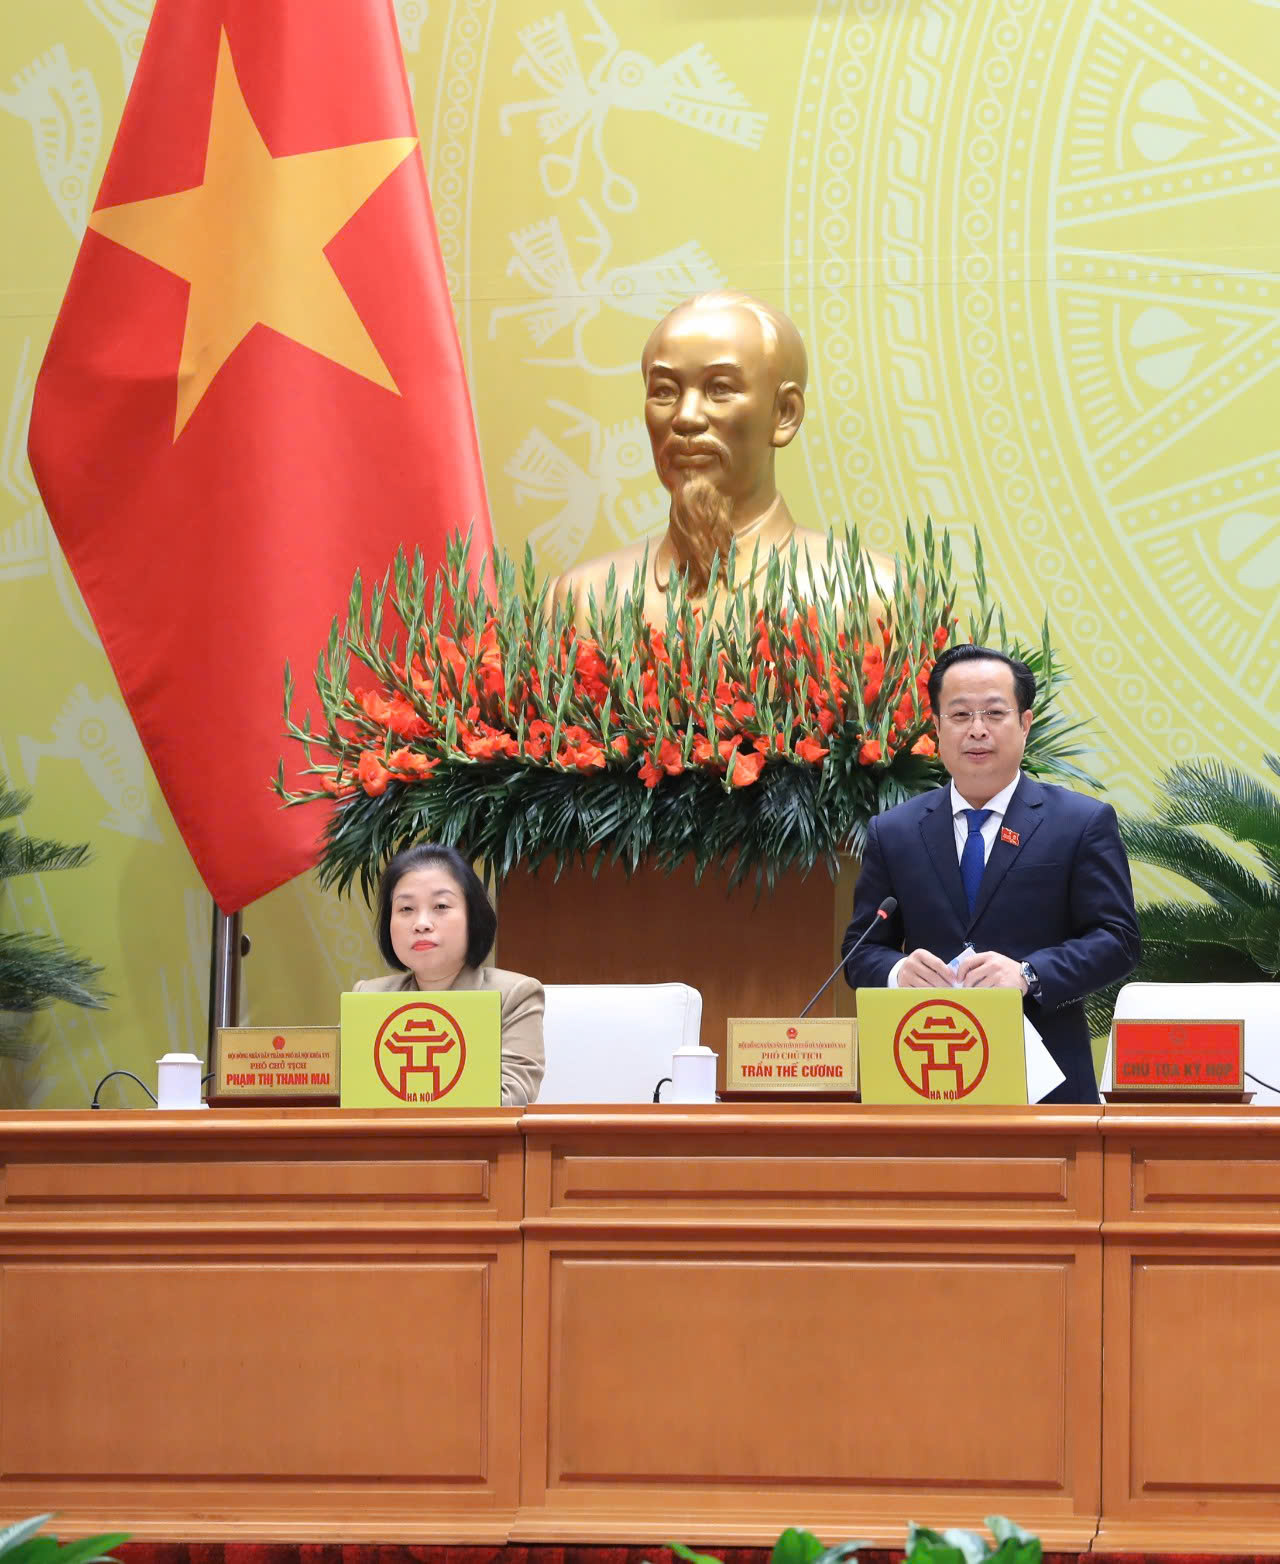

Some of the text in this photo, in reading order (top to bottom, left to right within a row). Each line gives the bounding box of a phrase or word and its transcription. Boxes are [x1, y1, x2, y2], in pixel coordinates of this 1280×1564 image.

[776, 1061, 798, 1078] THẾ
[801, 1064, 843, 1078] CƯƠNG
[226, 1073, 330, 1088] PHẠM THỊ THANH MAI
